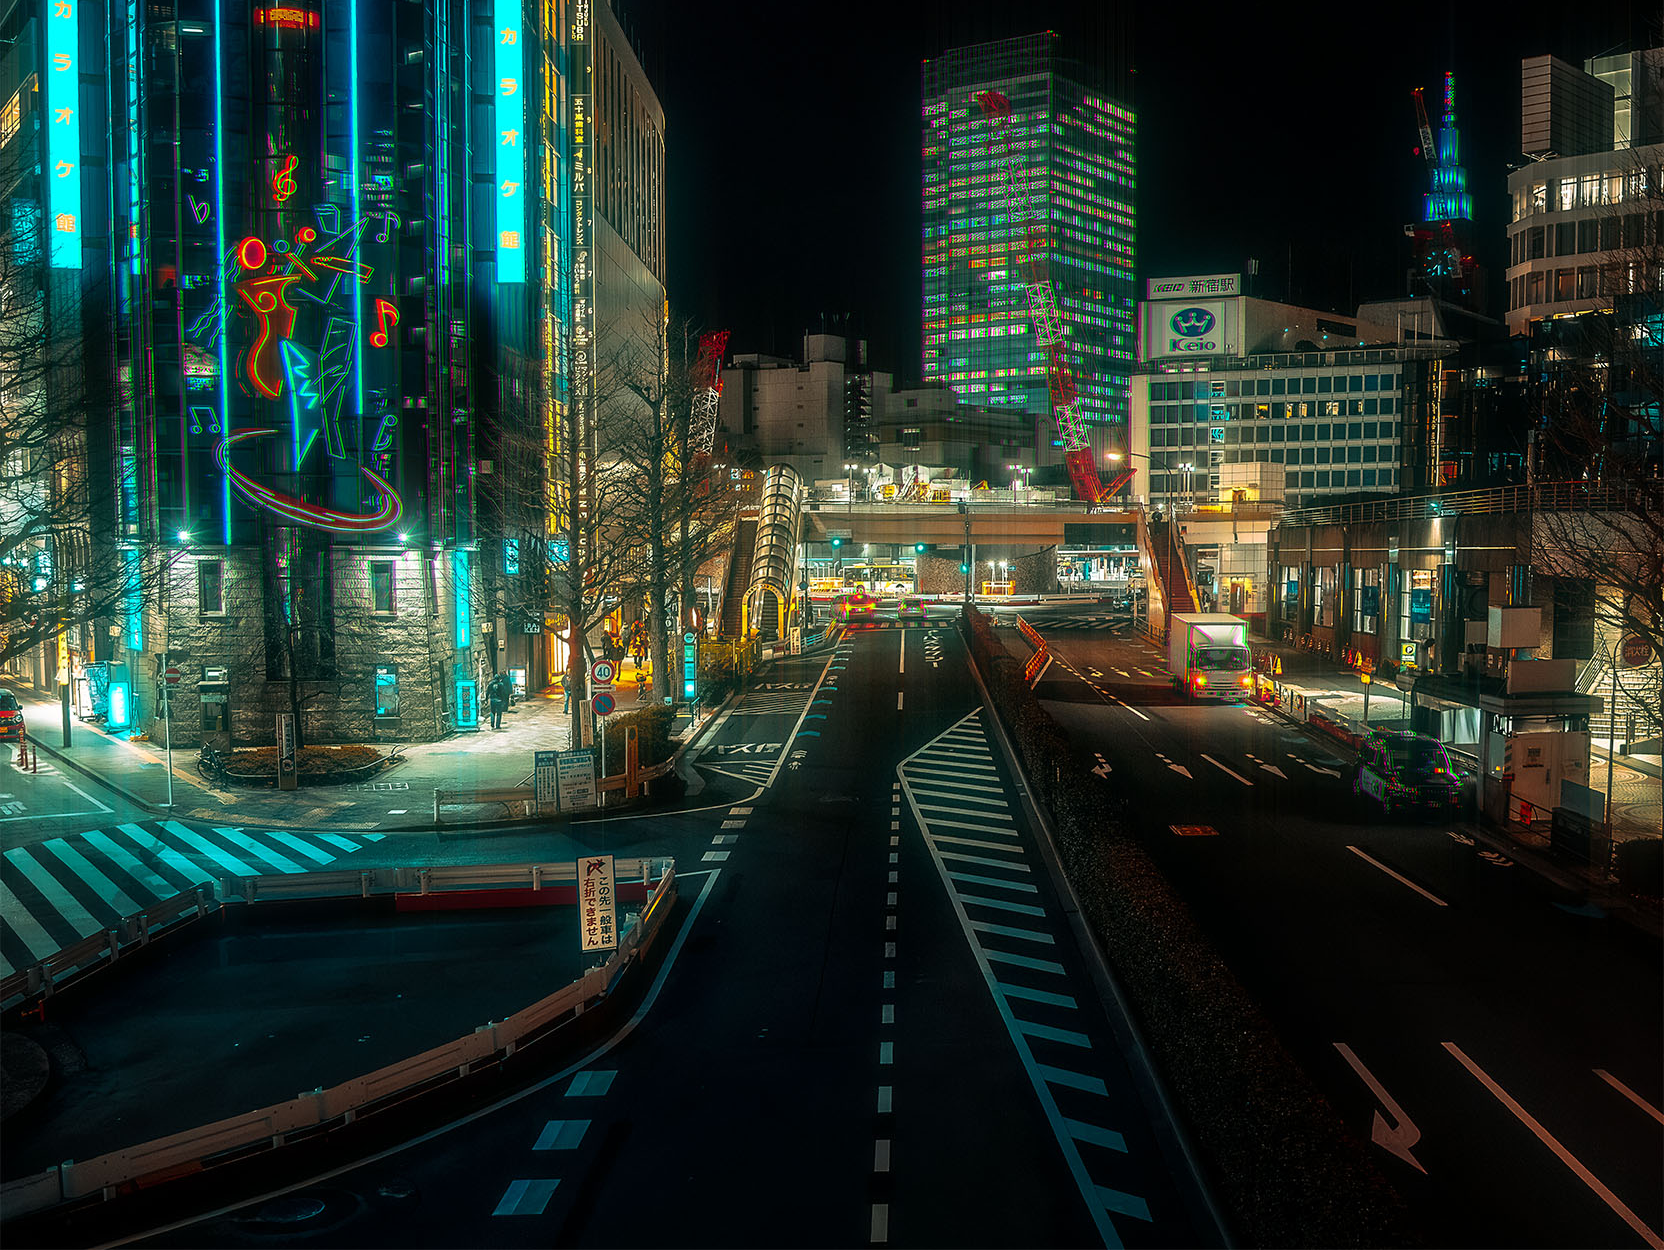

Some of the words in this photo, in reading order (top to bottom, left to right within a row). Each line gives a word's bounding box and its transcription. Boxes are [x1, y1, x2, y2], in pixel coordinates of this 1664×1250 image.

[53, 0, 77, 233] カラオケ館
[586, 116, 592, 124] 9
[500, 27, 521, 249] カラオケ館
[587, 167, 592, 175] 8
[587, 219, 592, 227] 7
[587, 270, 593, 278] 7
[1189, 277, 1234, 293] 新宿駅
[587, 307, 593, 315] 6
[1169, 337, 1216, 352] Keio
[596, 665, 611, 678] 40
[583, 878, 599, 947] 右折できません
[598, 876, 613, 945] この先一般車は
